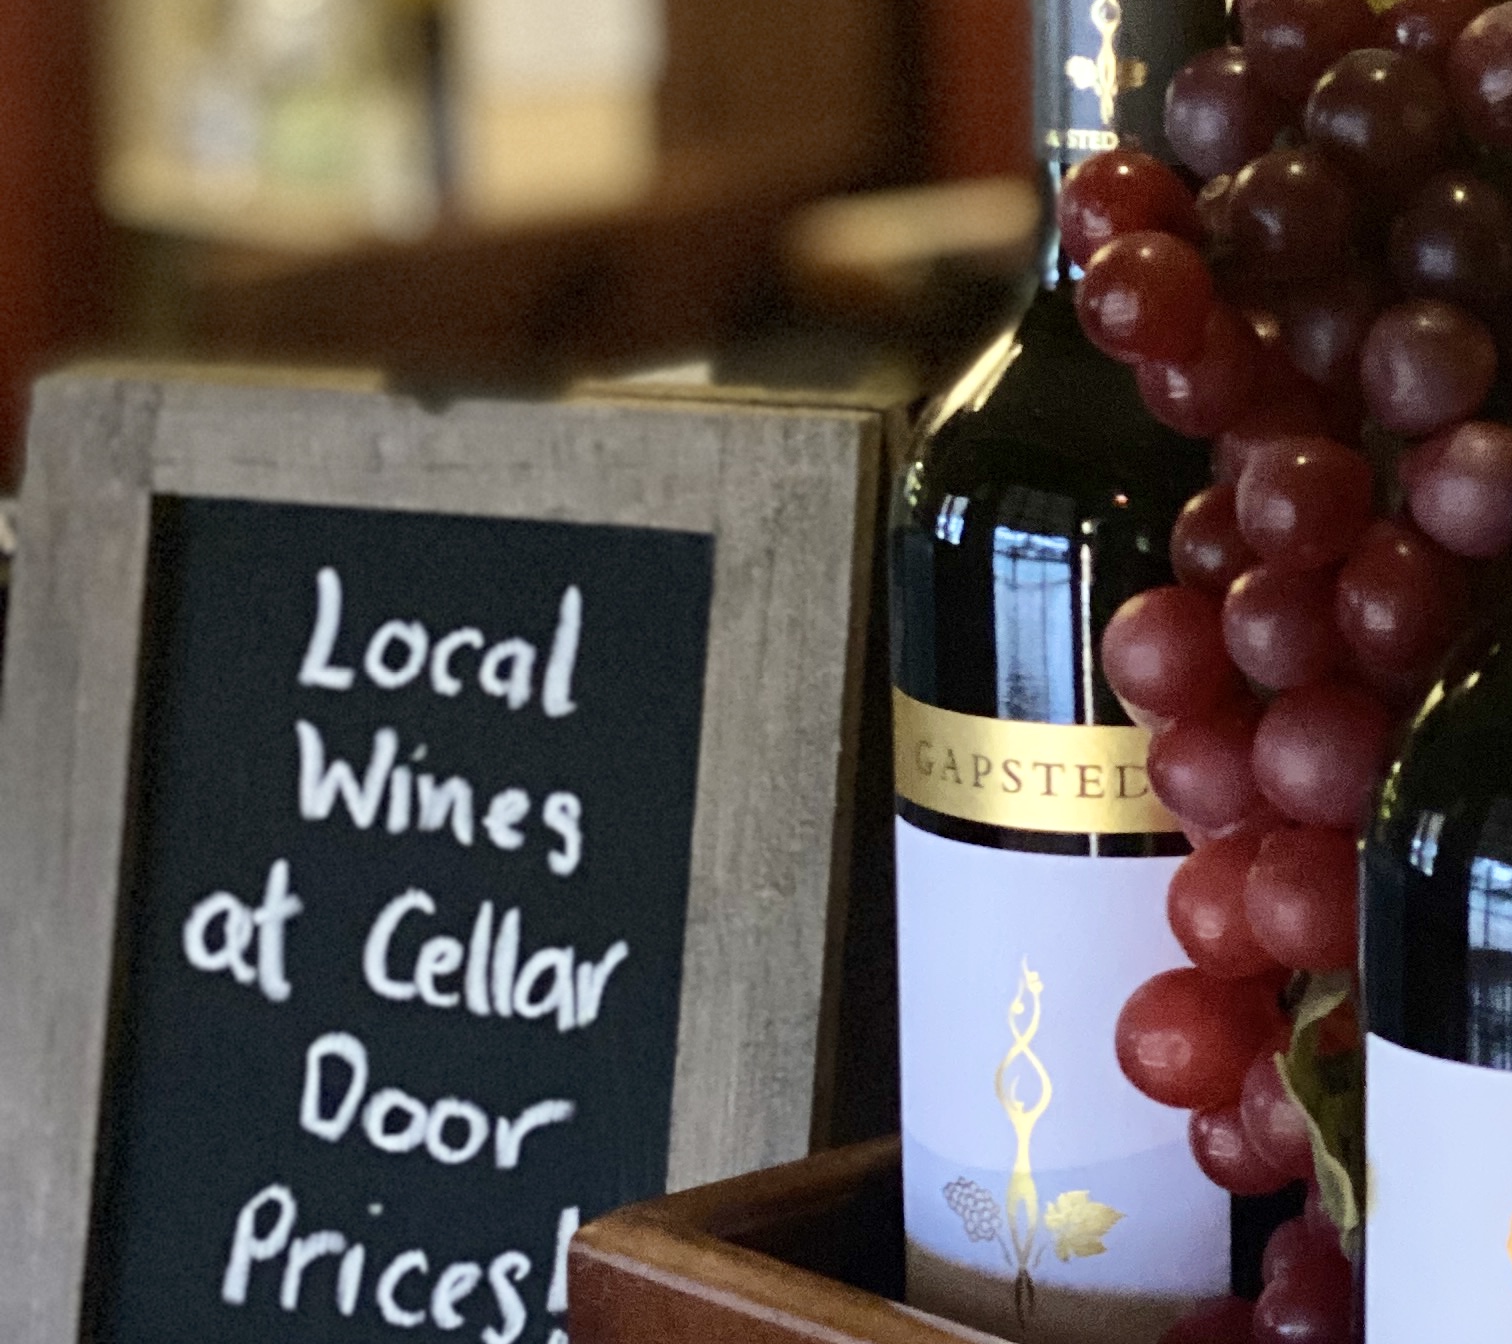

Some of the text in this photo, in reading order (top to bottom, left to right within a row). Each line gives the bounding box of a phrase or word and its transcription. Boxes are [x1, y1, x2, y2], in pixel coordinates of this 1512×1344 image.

[298, 566, 582, 718] Local
[294, 719, 582, 874] Wines
[915, 739, 1149, 799] GAPSTED
[183, 859, 630, 1032] at Cellar
[299, 1032, 577, 1170] Door
